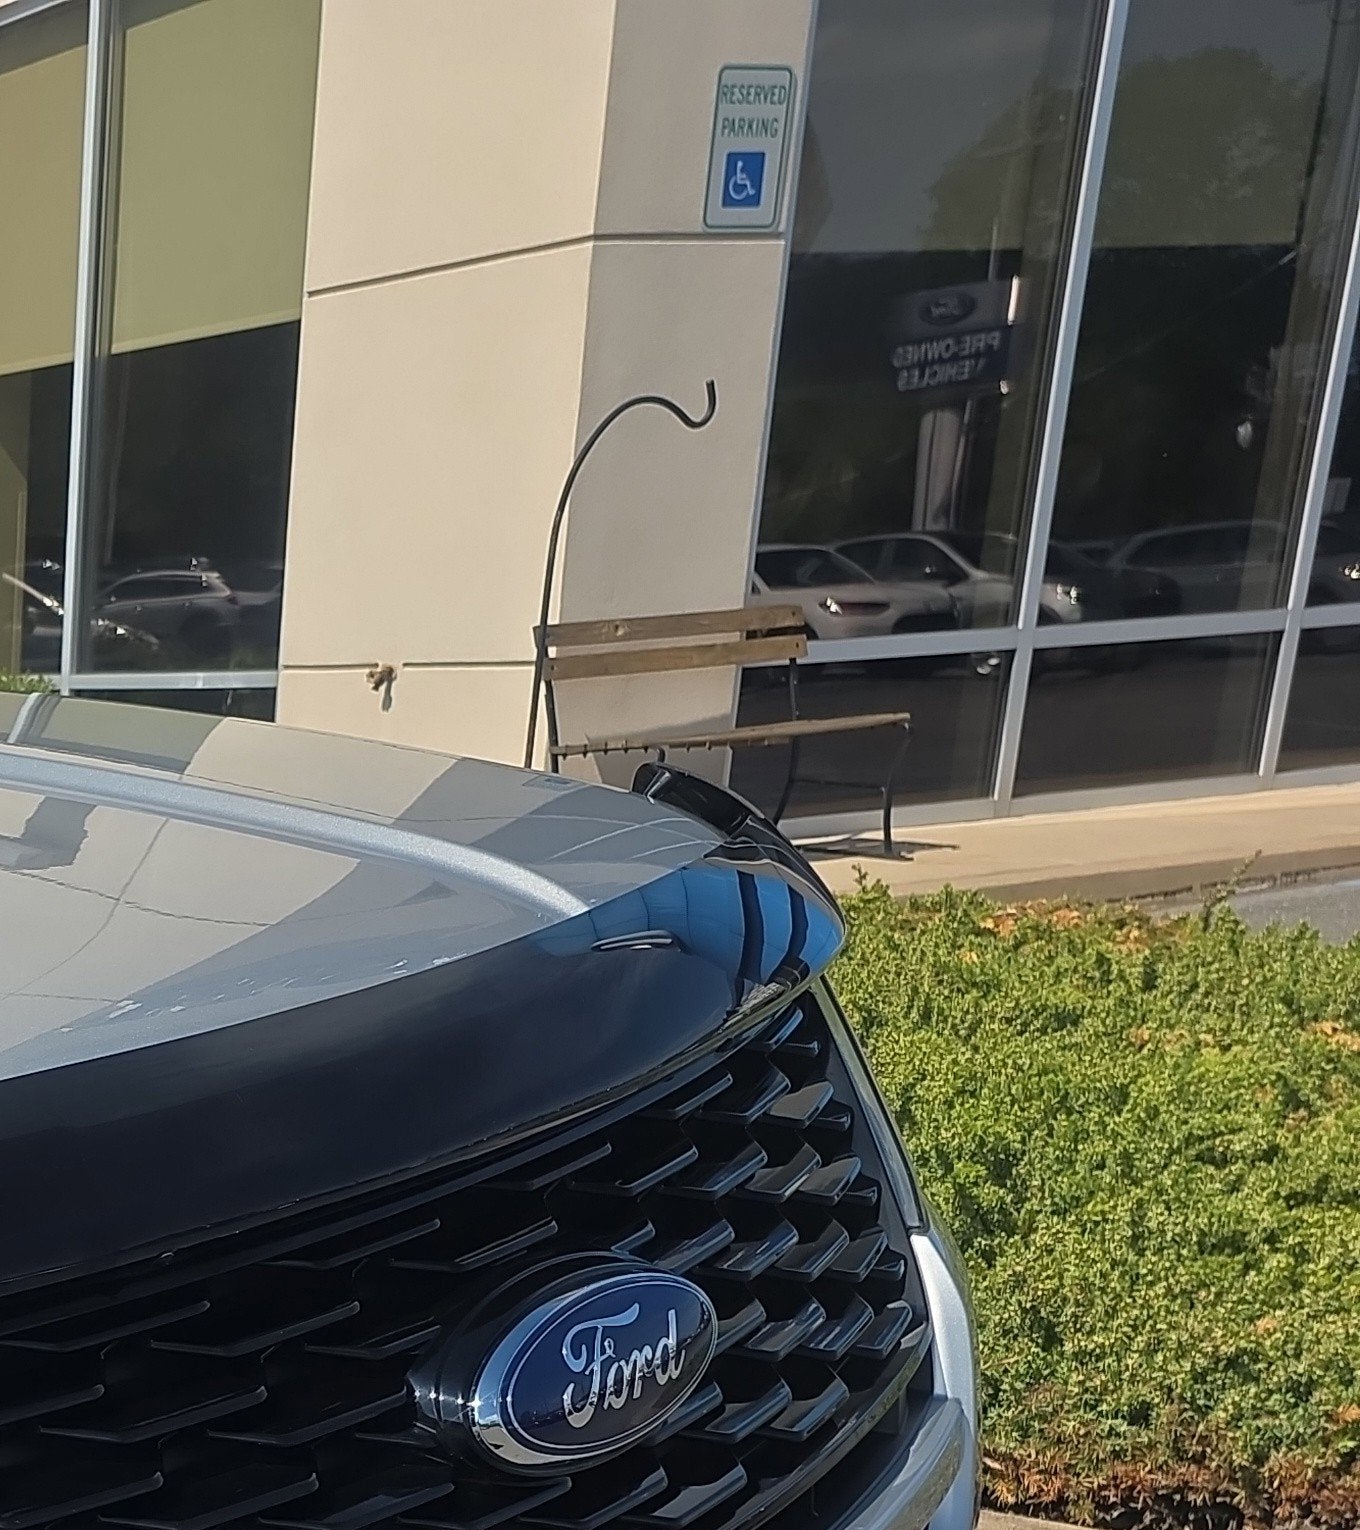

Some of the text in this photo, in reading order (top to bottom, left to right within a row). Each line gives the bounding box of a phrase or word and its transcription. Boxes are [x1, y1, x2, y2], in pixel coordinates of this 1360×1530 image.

[720, 84, 787, 105] RESERVED
[721, 117, 779, 138] PARKING
[561, 1302, 686, 1428] Ford
